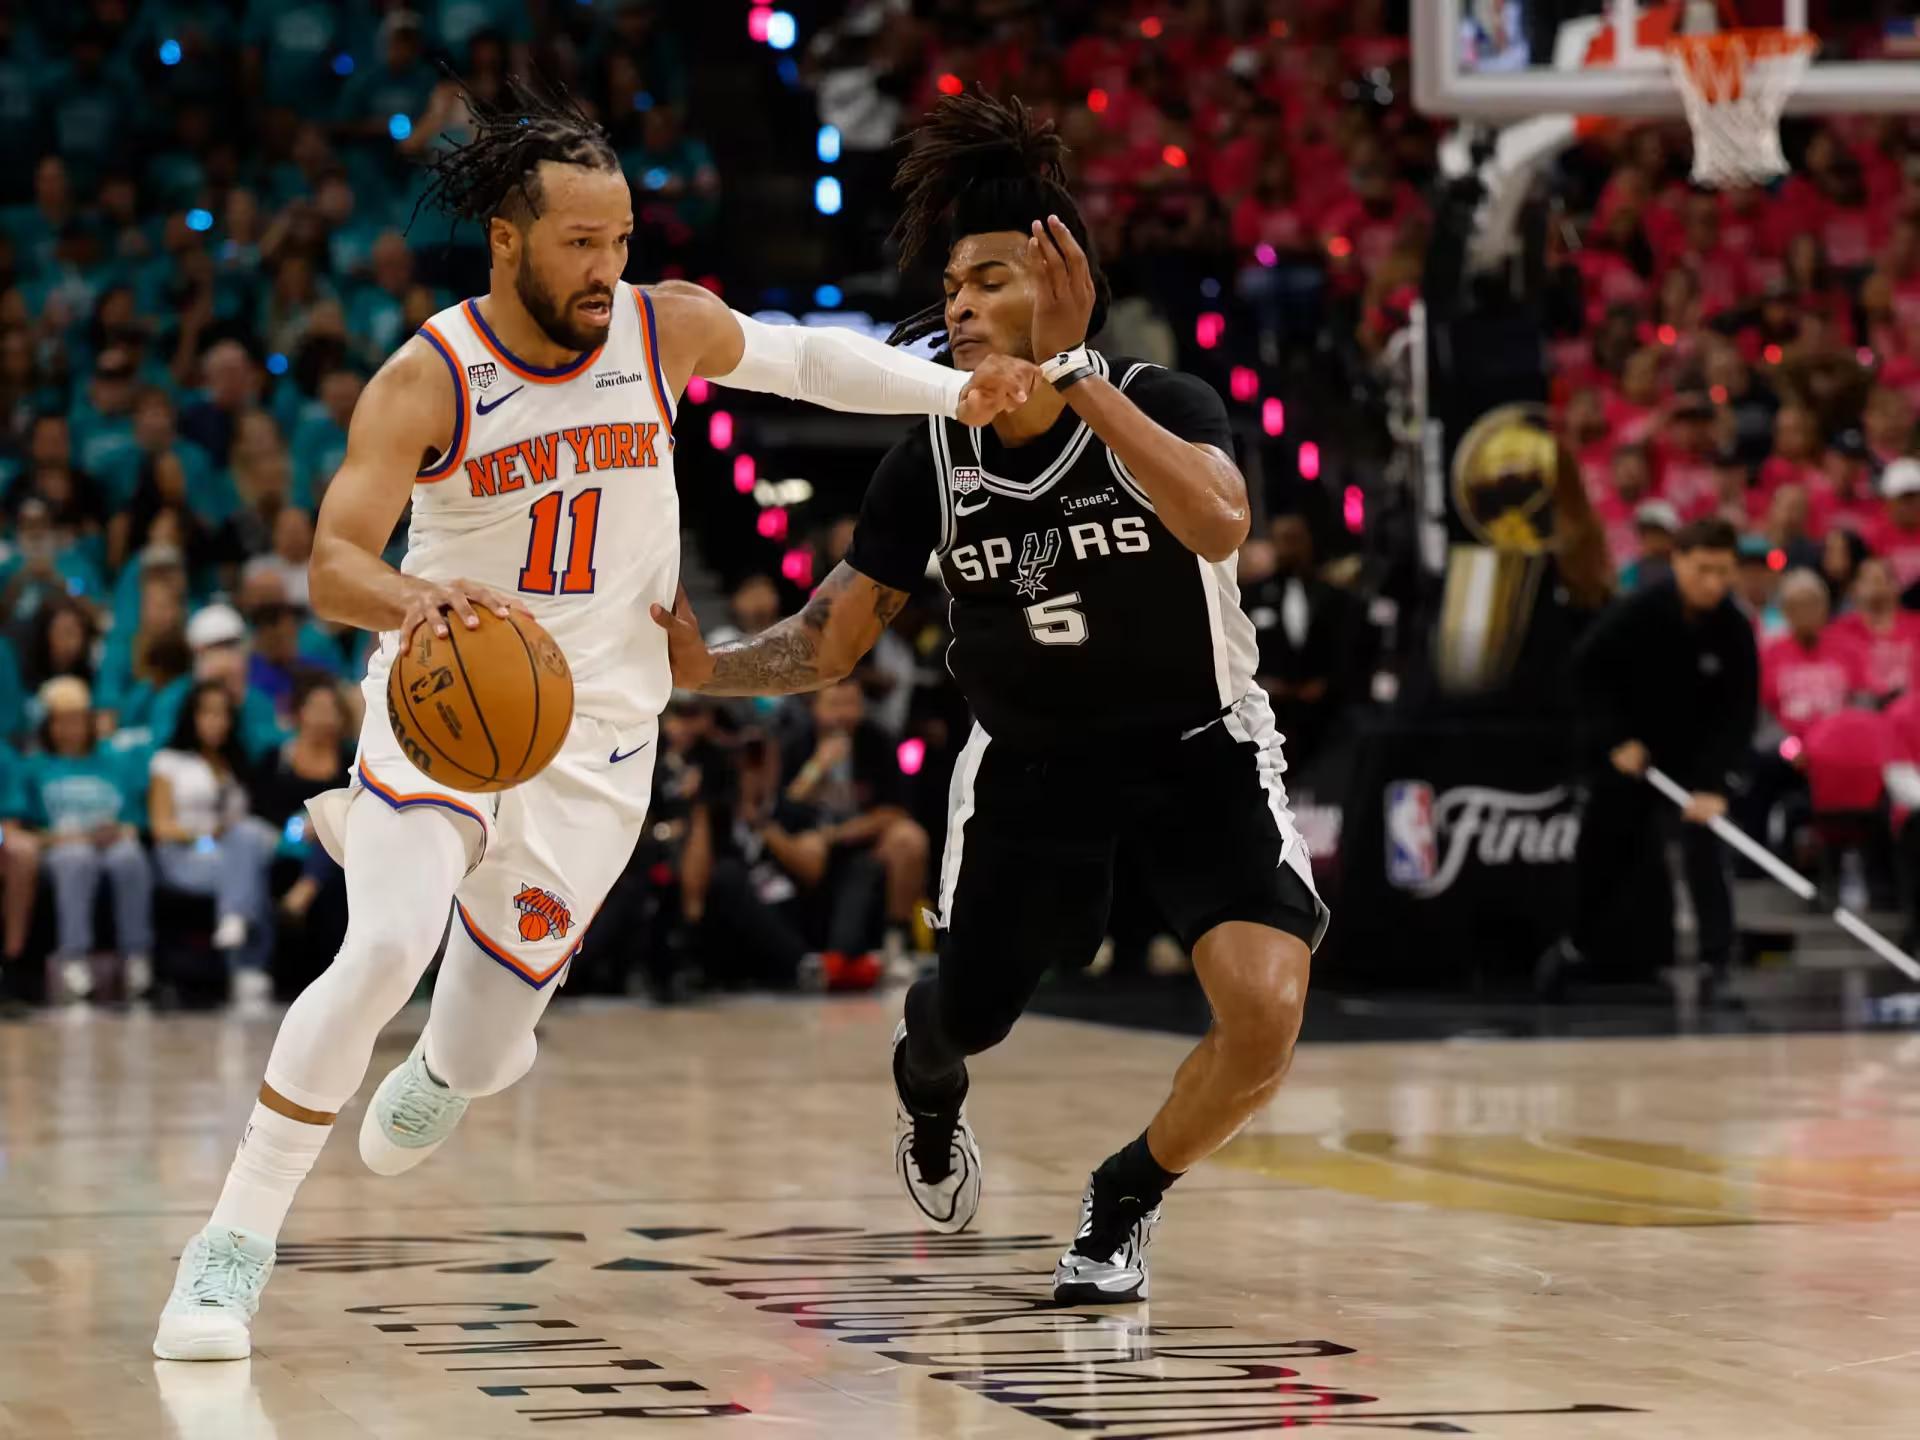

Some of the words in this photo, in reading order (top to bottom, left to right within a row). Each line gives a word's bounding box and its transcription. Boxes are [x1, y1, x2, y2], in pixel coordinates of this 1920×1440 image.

[470, 364, 494, 374] USA
[595, 378, 615, 389] abu
[616, 371, 642, 385] dhabi
[464, 433, 560, 498] NEW
[563, 422, 660, 475] YORK
[956, 470, 978, 478] USA
[1068, 493, 1110, 509] LEDGER
[517, 487, 603, 596] 11
[1023, 591, 1090, 646] 5
[1412, 784, 1588, 900] Fina
[343, 1301, 752, 1422] CENTER
